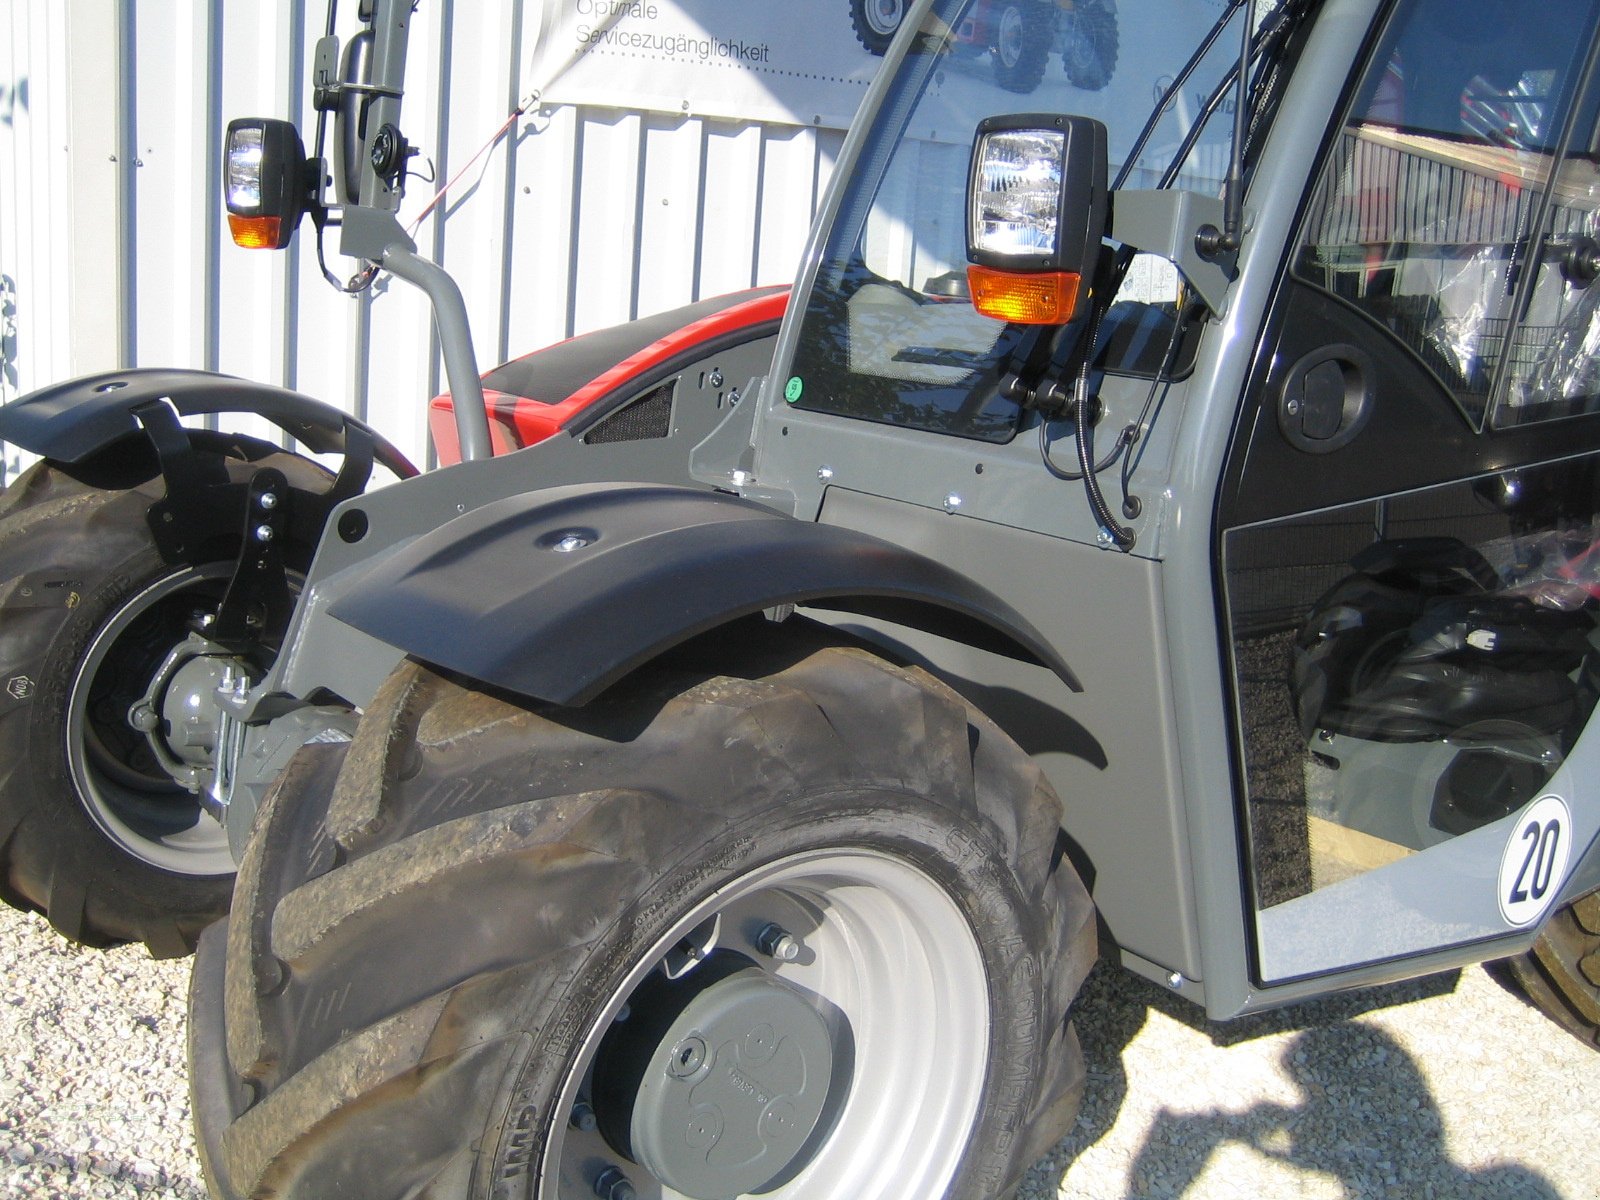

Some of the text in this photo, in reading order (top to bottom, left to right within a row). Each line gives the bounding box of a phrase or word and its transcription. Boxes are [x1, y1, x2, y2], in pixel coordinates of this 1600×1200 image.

[576, 0, 658, 19] Optimale
[576, 24, 770, 63] Servicezugänglichkeit
[1508, 818, 1560, 904] 20
